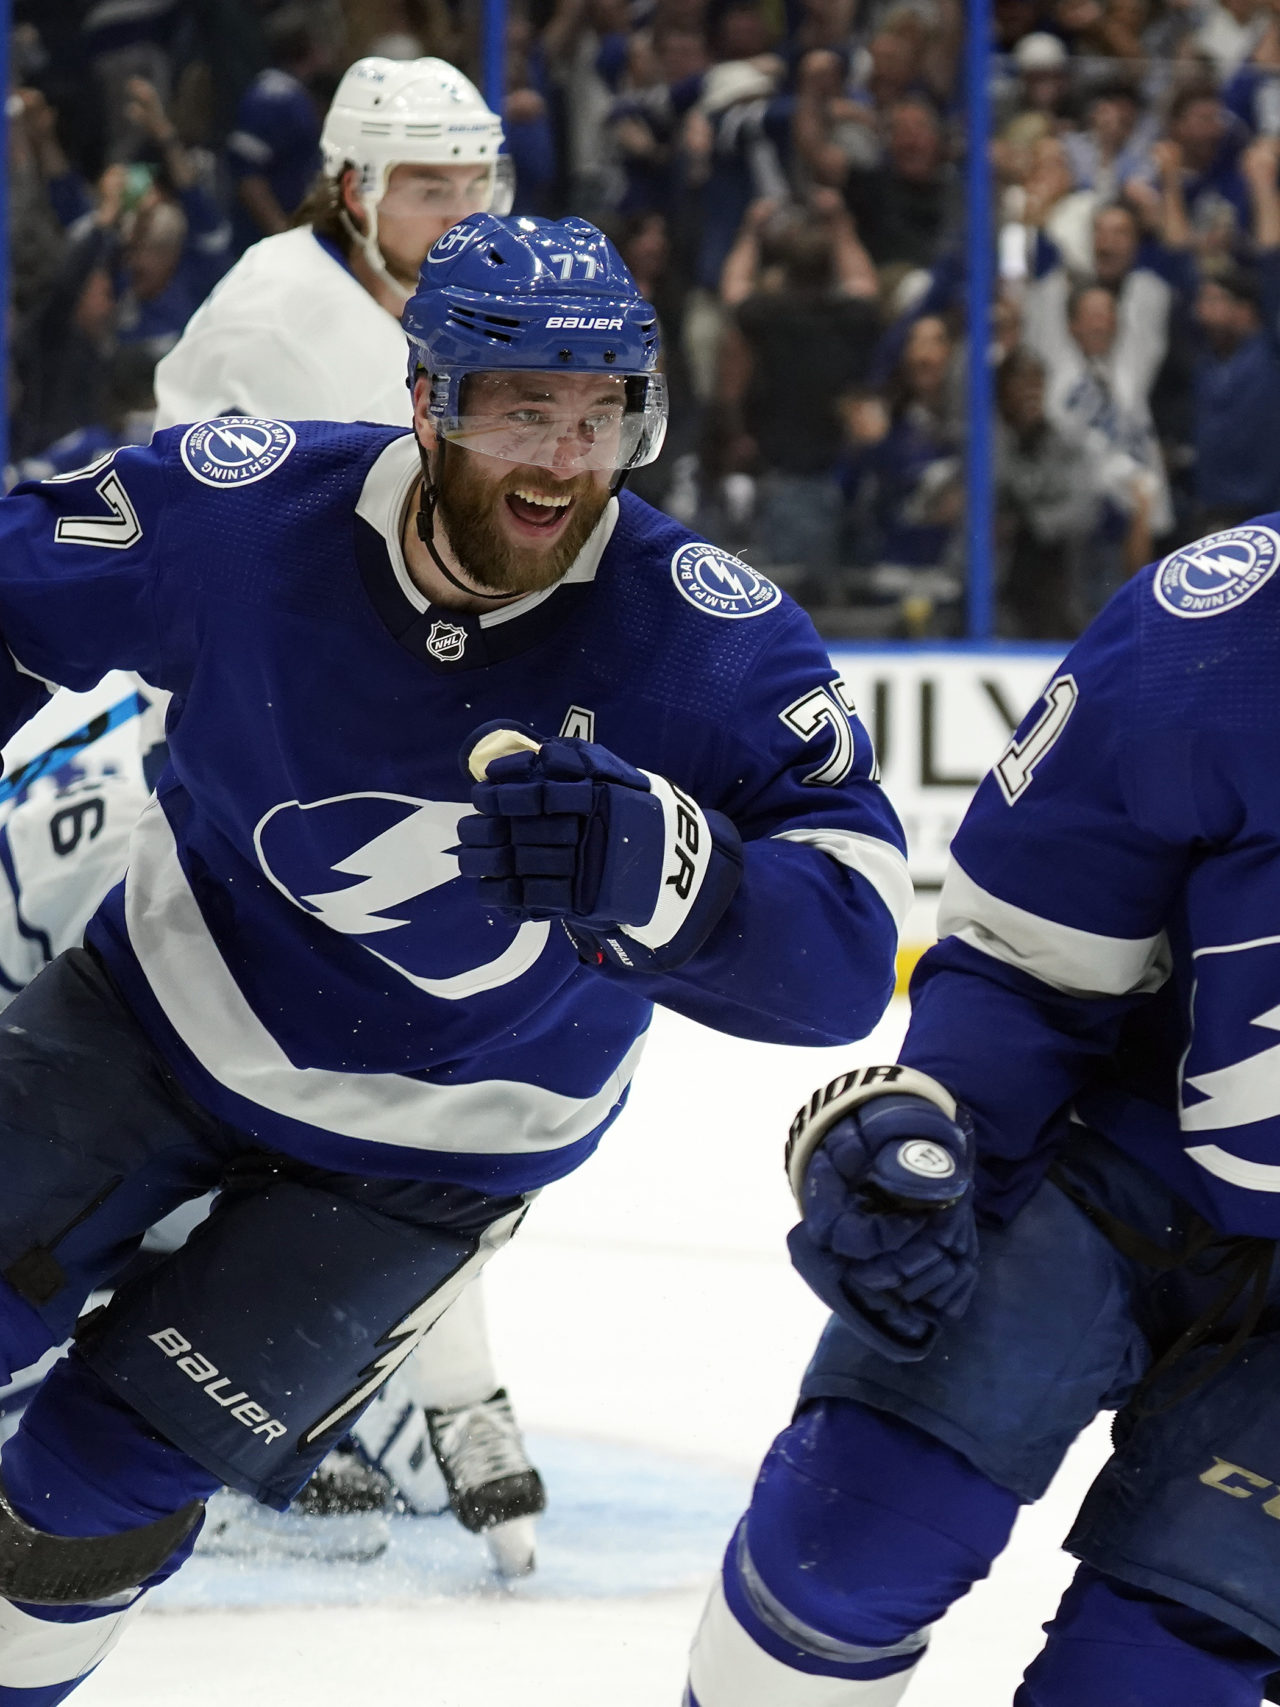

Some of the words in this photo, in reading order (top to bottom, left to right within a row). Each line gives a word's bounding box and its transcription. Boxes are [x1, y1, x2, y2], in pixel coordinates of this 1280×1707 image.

[550, 253, 597, 280] 77
[220, 419, 274, 430] TAMPA
[271, 427, 289, 445] BAY
[201, 446, 283, 480] LIGHTNING
[680, 556, 694, 580] BAY
[688, 582, 740, 611] TAMPA
[1180, 559, 1271, 609] LIGHTNING
[434, 636, 459, 651] NHL
[147, 1327, 288, 1446] BAUER
